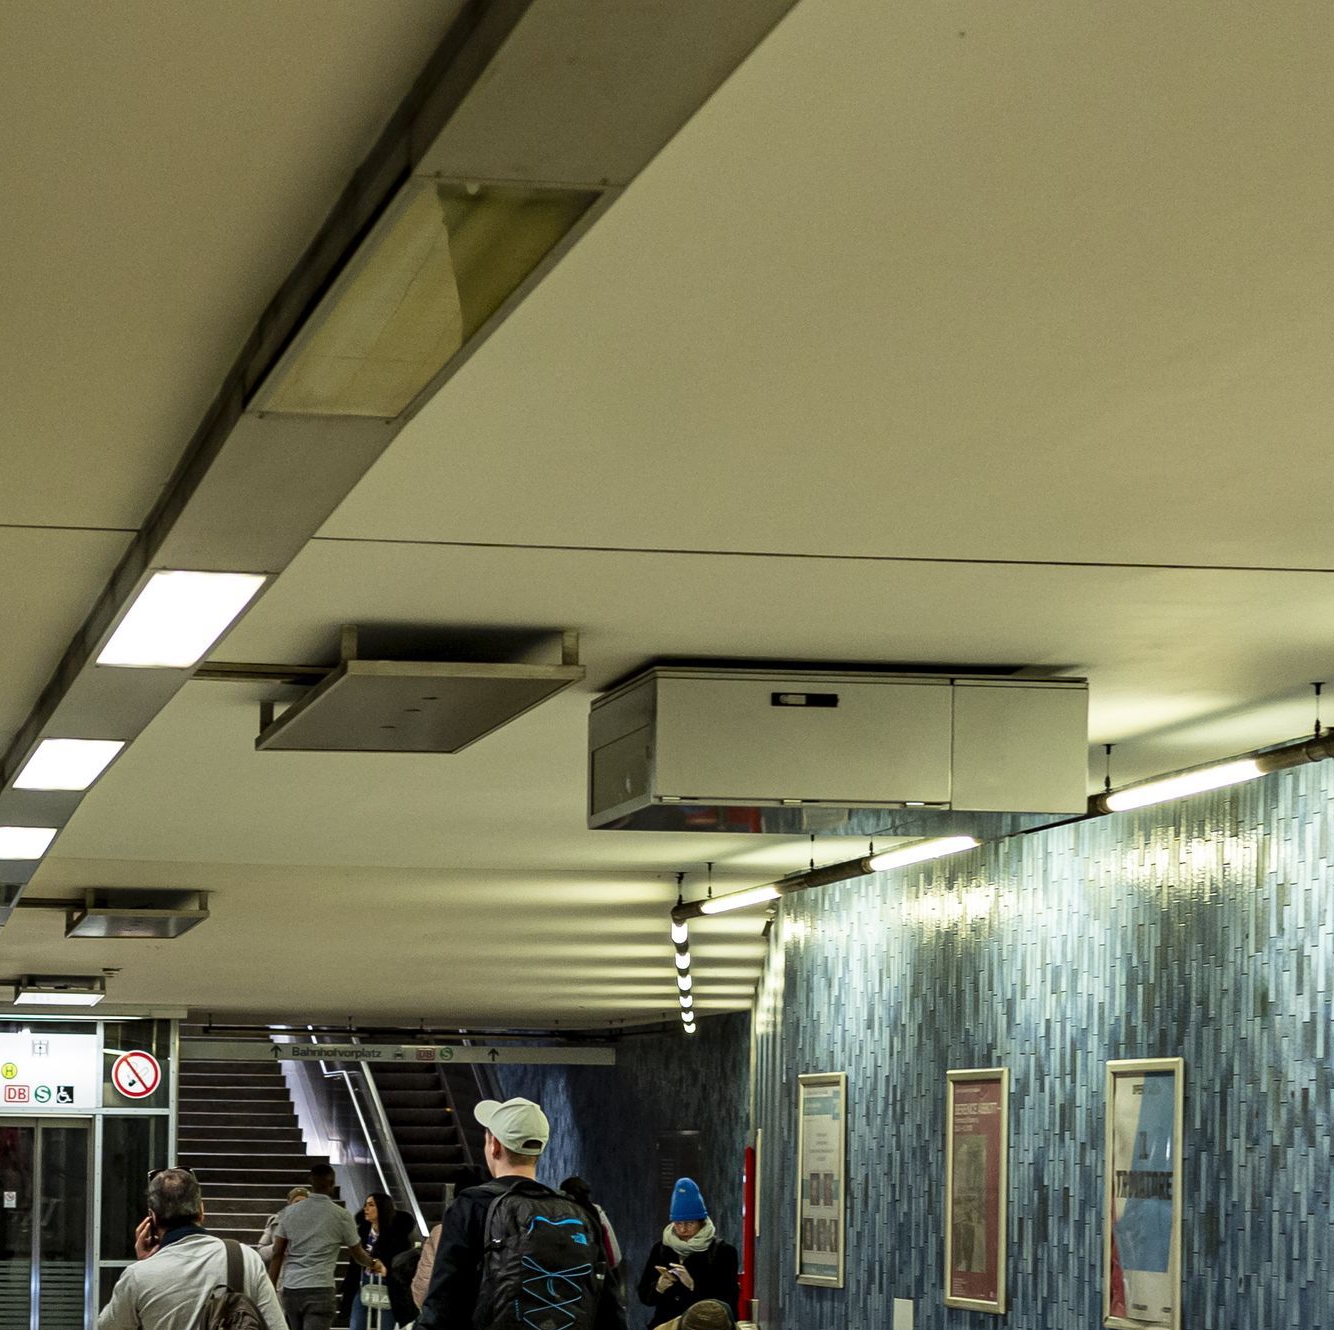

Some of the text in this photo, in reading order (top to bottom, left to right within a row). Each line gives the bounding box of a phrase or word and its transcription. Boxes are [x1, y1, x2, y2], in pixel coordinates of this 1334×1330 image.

[440, 1048, 453, 1060] S
[7, 1086, 51, 1102] DB S
